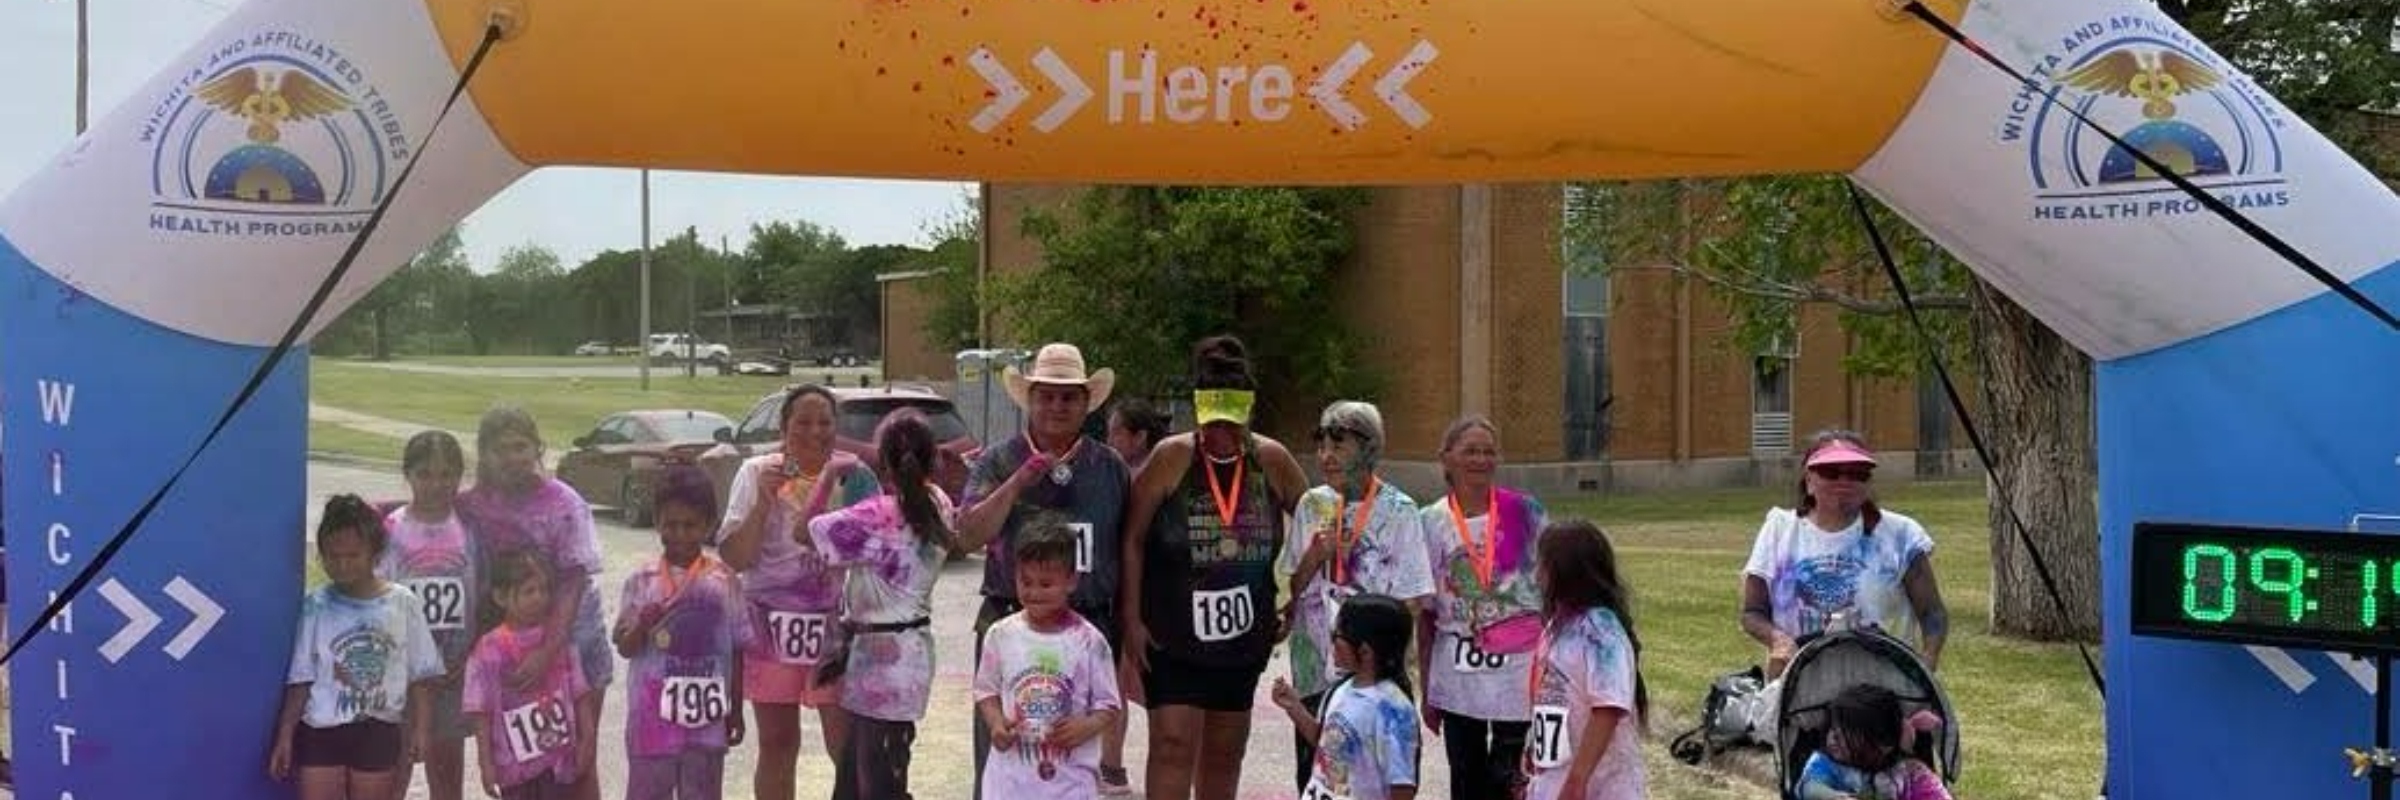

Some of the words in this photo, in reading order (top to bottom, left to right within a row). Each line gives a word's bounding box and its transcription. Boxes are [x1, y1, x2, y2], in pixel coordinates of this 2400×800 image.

[2062, 22, 2105, 52] AND
[140, 68, 203, 142] WICHITA
[209, 39, 245, 66] AND
[252, 31, 363, 83] AFFILIATED
[362, 86, 409, 161] TRIBES
[1106, 49, 1294, 123] Here
[149, 213, 241, 236] HEALTH
[2034, 202, 2139, 220] HEALTH
[2146, 191, 2290, 216] PRORAMS
[2183, 543, 2400, 627] 09:1
[1197, 592, 1250, 636] 180
[771, 617, 823, 660] 185
[666, 681, 722, 724] 196
